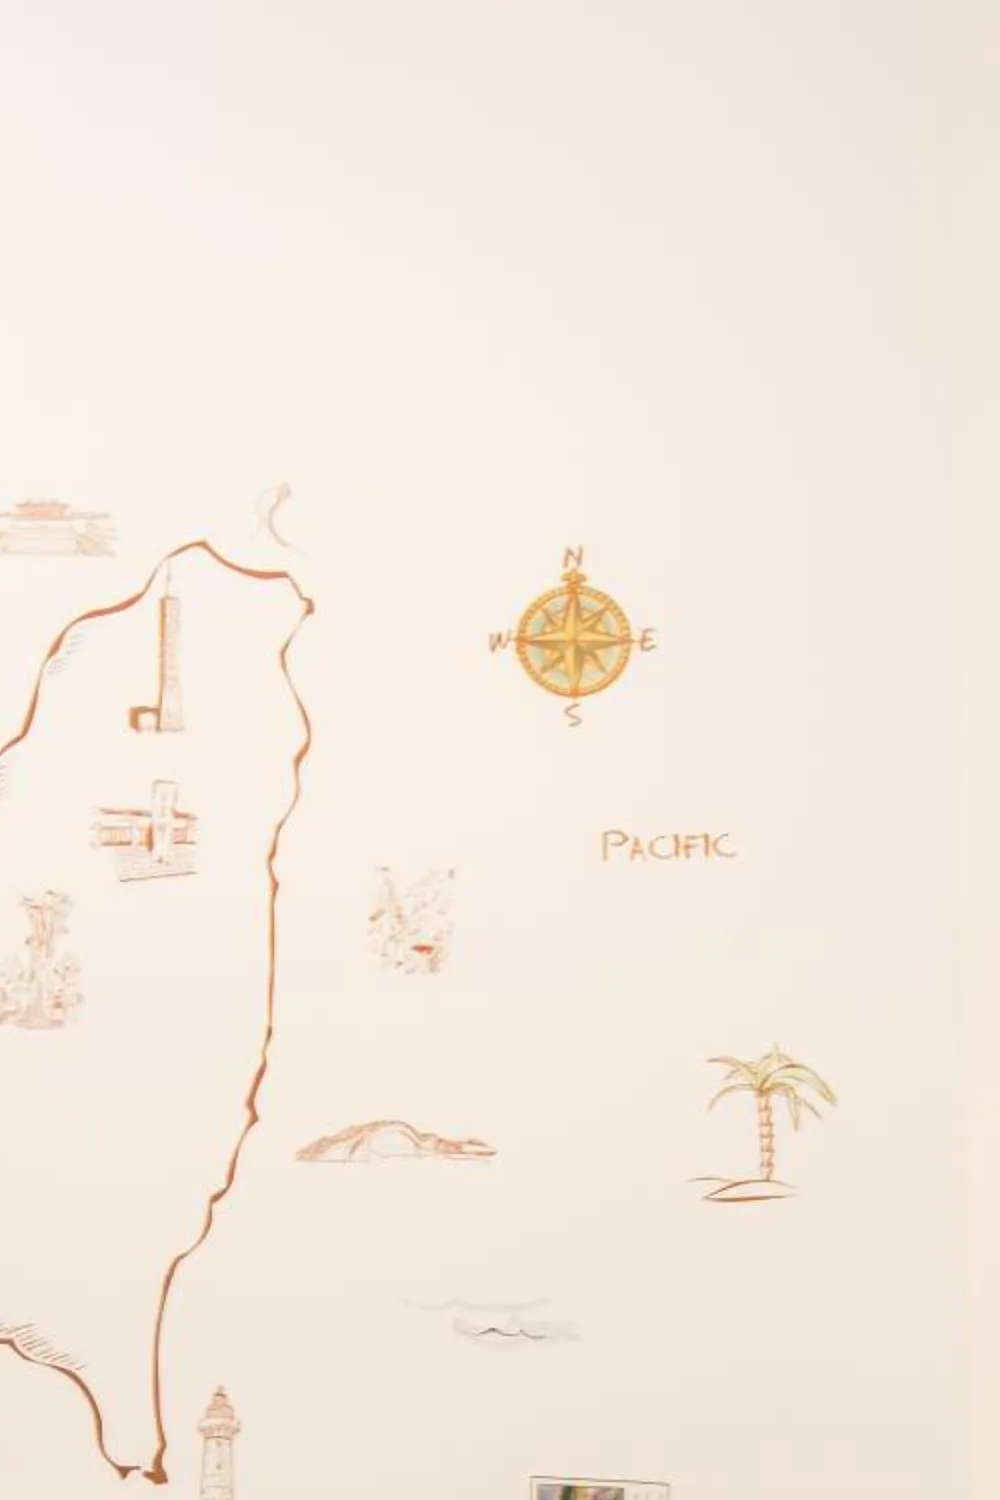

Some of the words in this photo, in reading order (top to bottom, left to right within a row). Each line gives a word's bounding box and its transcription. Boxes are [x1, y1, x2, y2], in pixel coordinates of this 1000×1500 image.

[562, 545, 584, 568] N
[488, 631, 513, 653] W
[638, 628, 657, 652] E
[563, 703, 583, 728] S
[601, 828, 738, 862] PACIFIC
